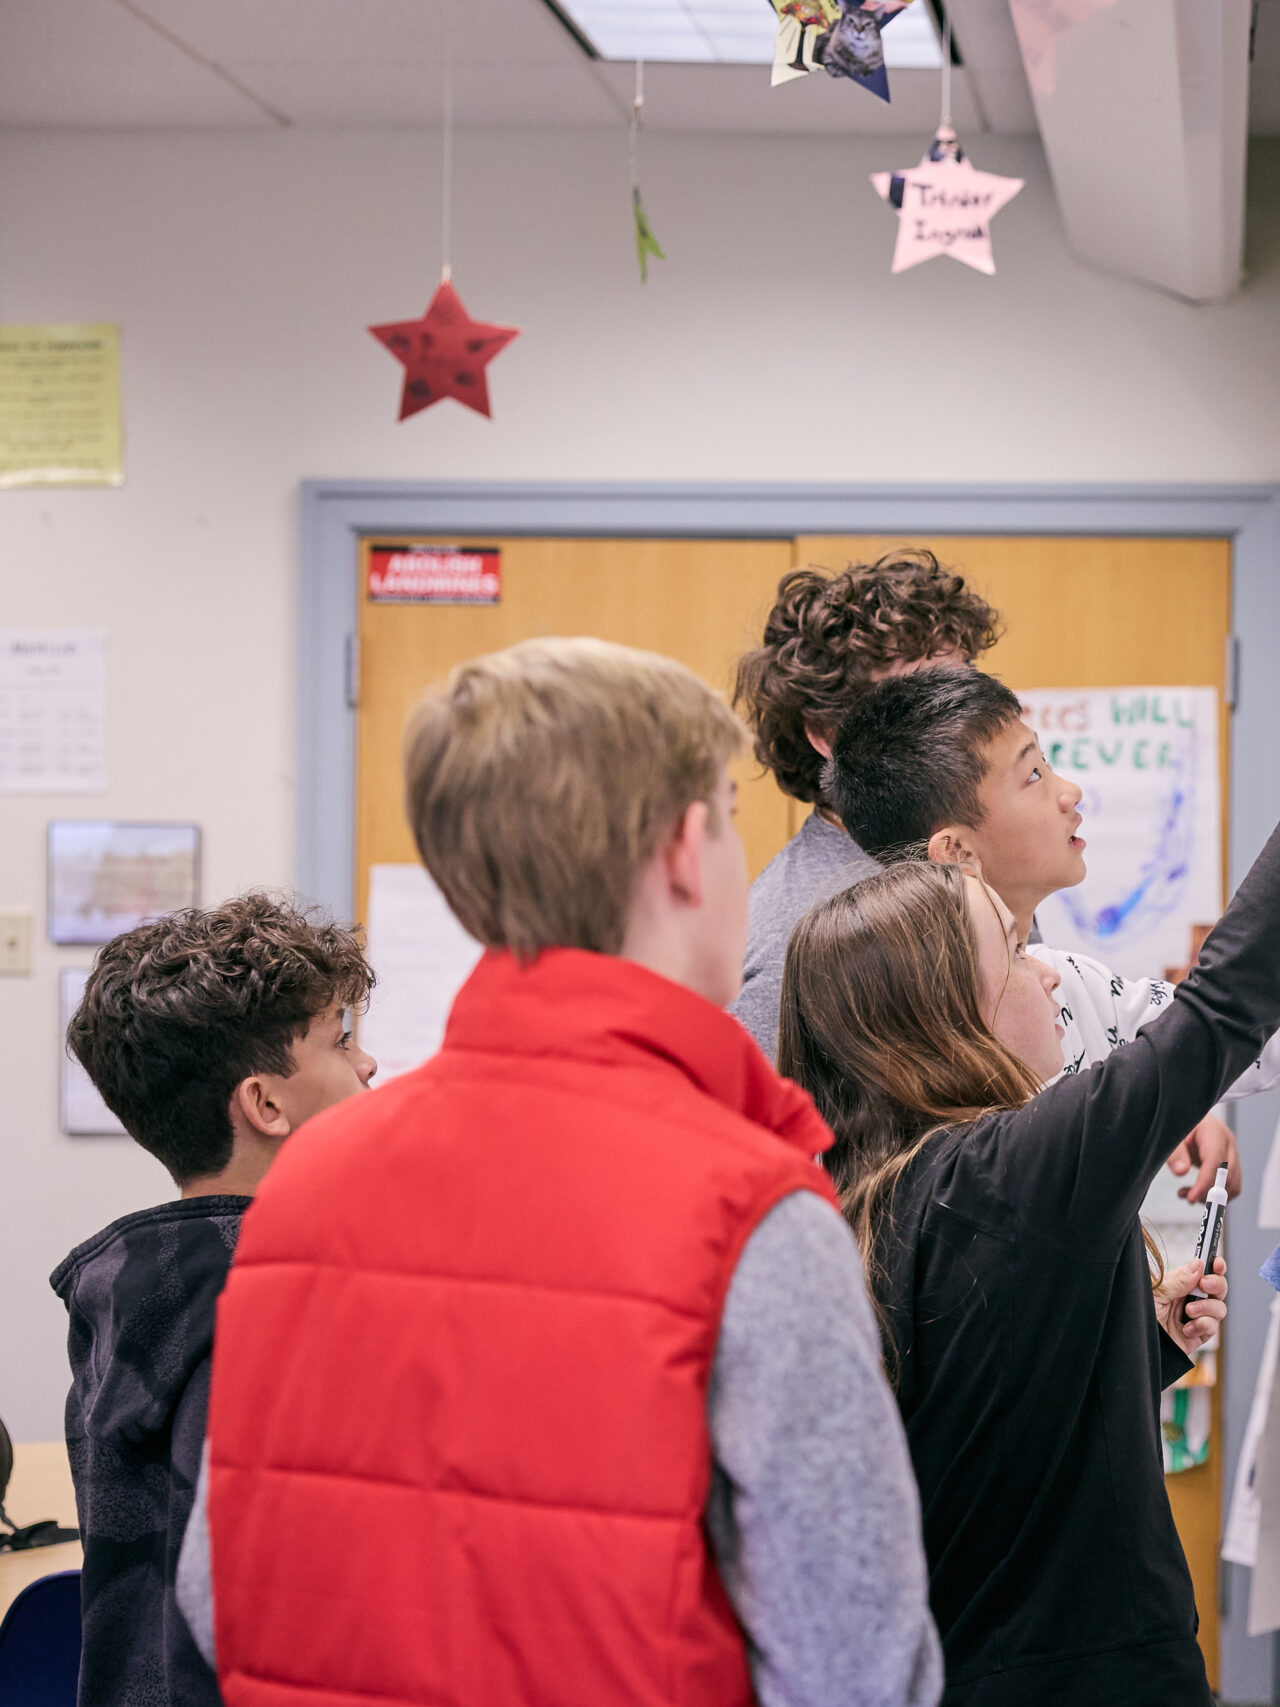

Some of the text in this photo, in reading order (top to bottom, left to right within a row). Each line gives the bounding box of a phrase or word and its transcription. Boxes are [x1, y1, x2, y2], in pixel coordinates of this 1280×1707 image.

[387, 553, 483, 572] ABOLISH
[370, 572, 500, 595] LANDMINES
[1110, 695, 1195, 728] WILL
